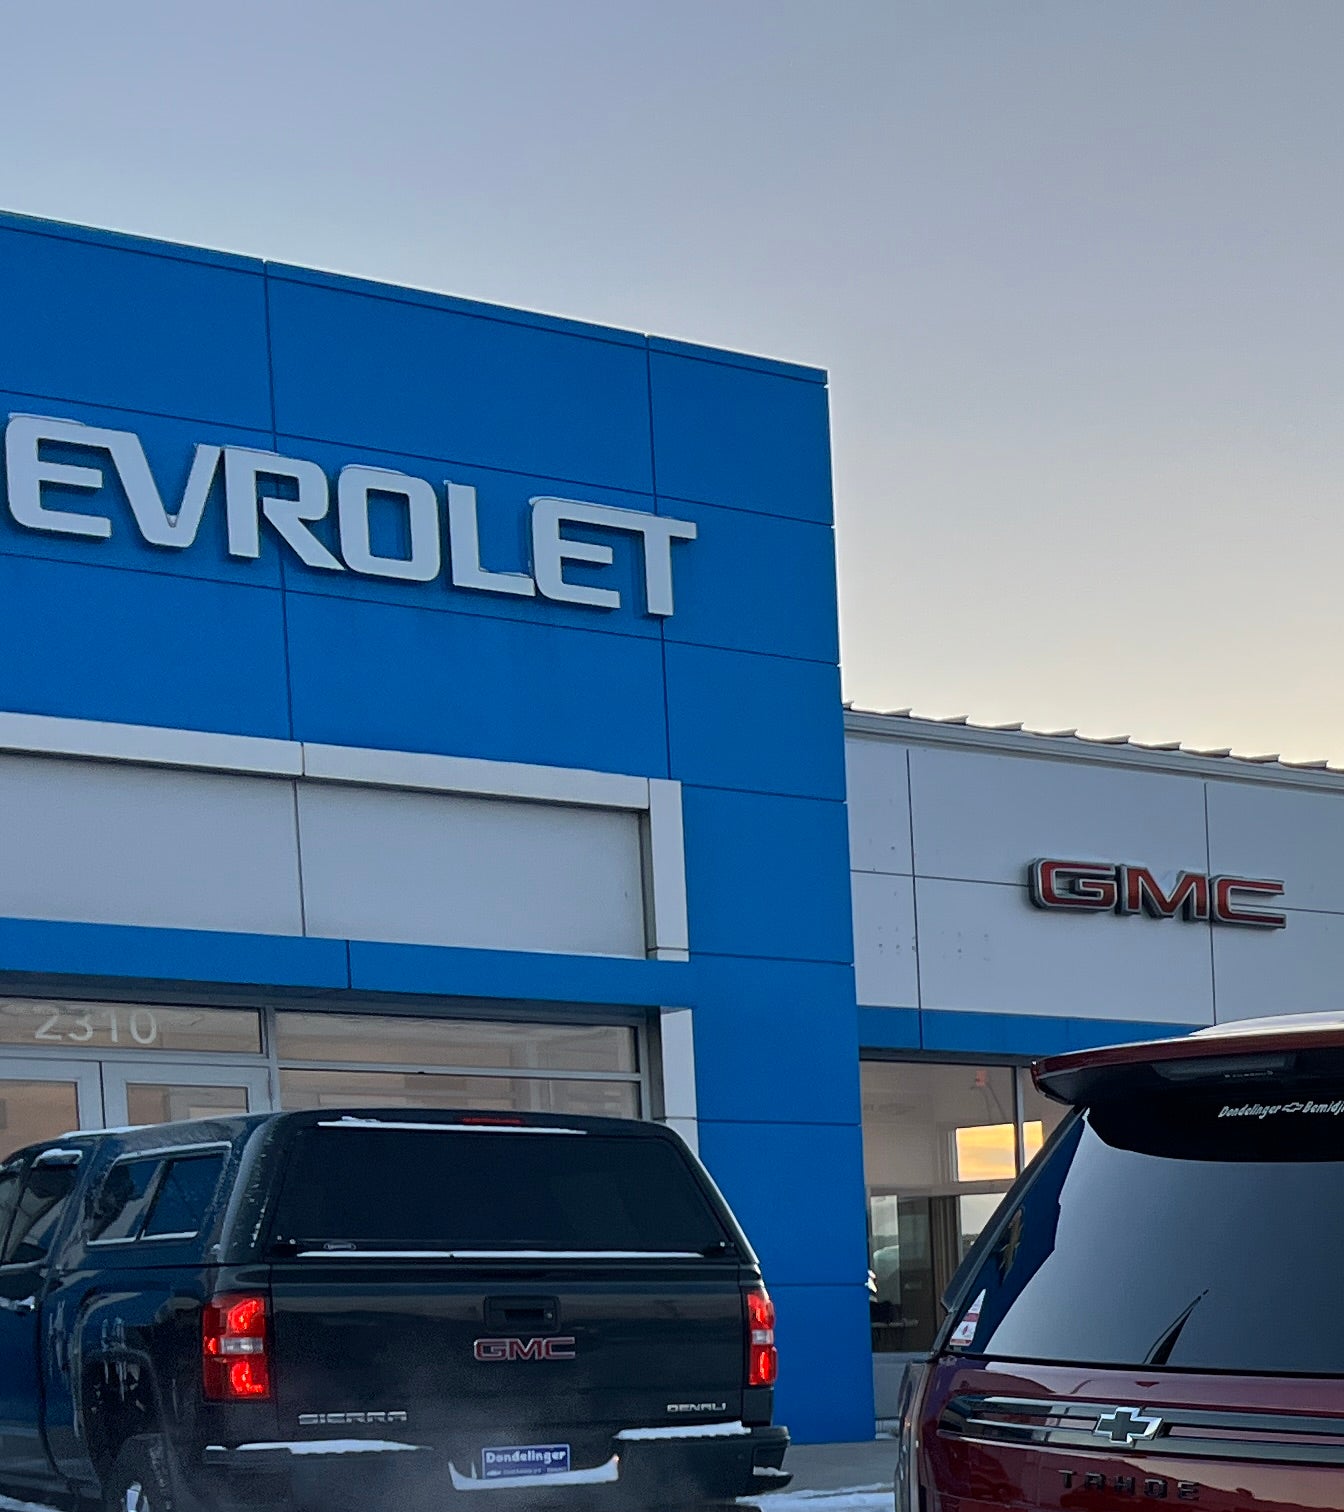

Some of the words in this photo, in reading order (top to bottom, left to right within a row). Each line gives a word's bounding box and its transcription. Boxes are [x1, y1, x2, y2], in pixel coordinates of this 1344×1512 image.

[5, 413, 697, 616] EVROLET
[1028, 857, 1287, 929] GMC
[34, 1004, 158, 1045] 2310
[1217, 1103, 1282, 1119] Dondelinger
[473, 1336, 576, 1361] GMC
[298, 1410, 408, 1425] SIERRA
[666, 1402, 727, 1413] DENALI
[485, 1450, 566, 1465] Dondelinger
[1058, 1469, 1202, 1501] TAHOE
